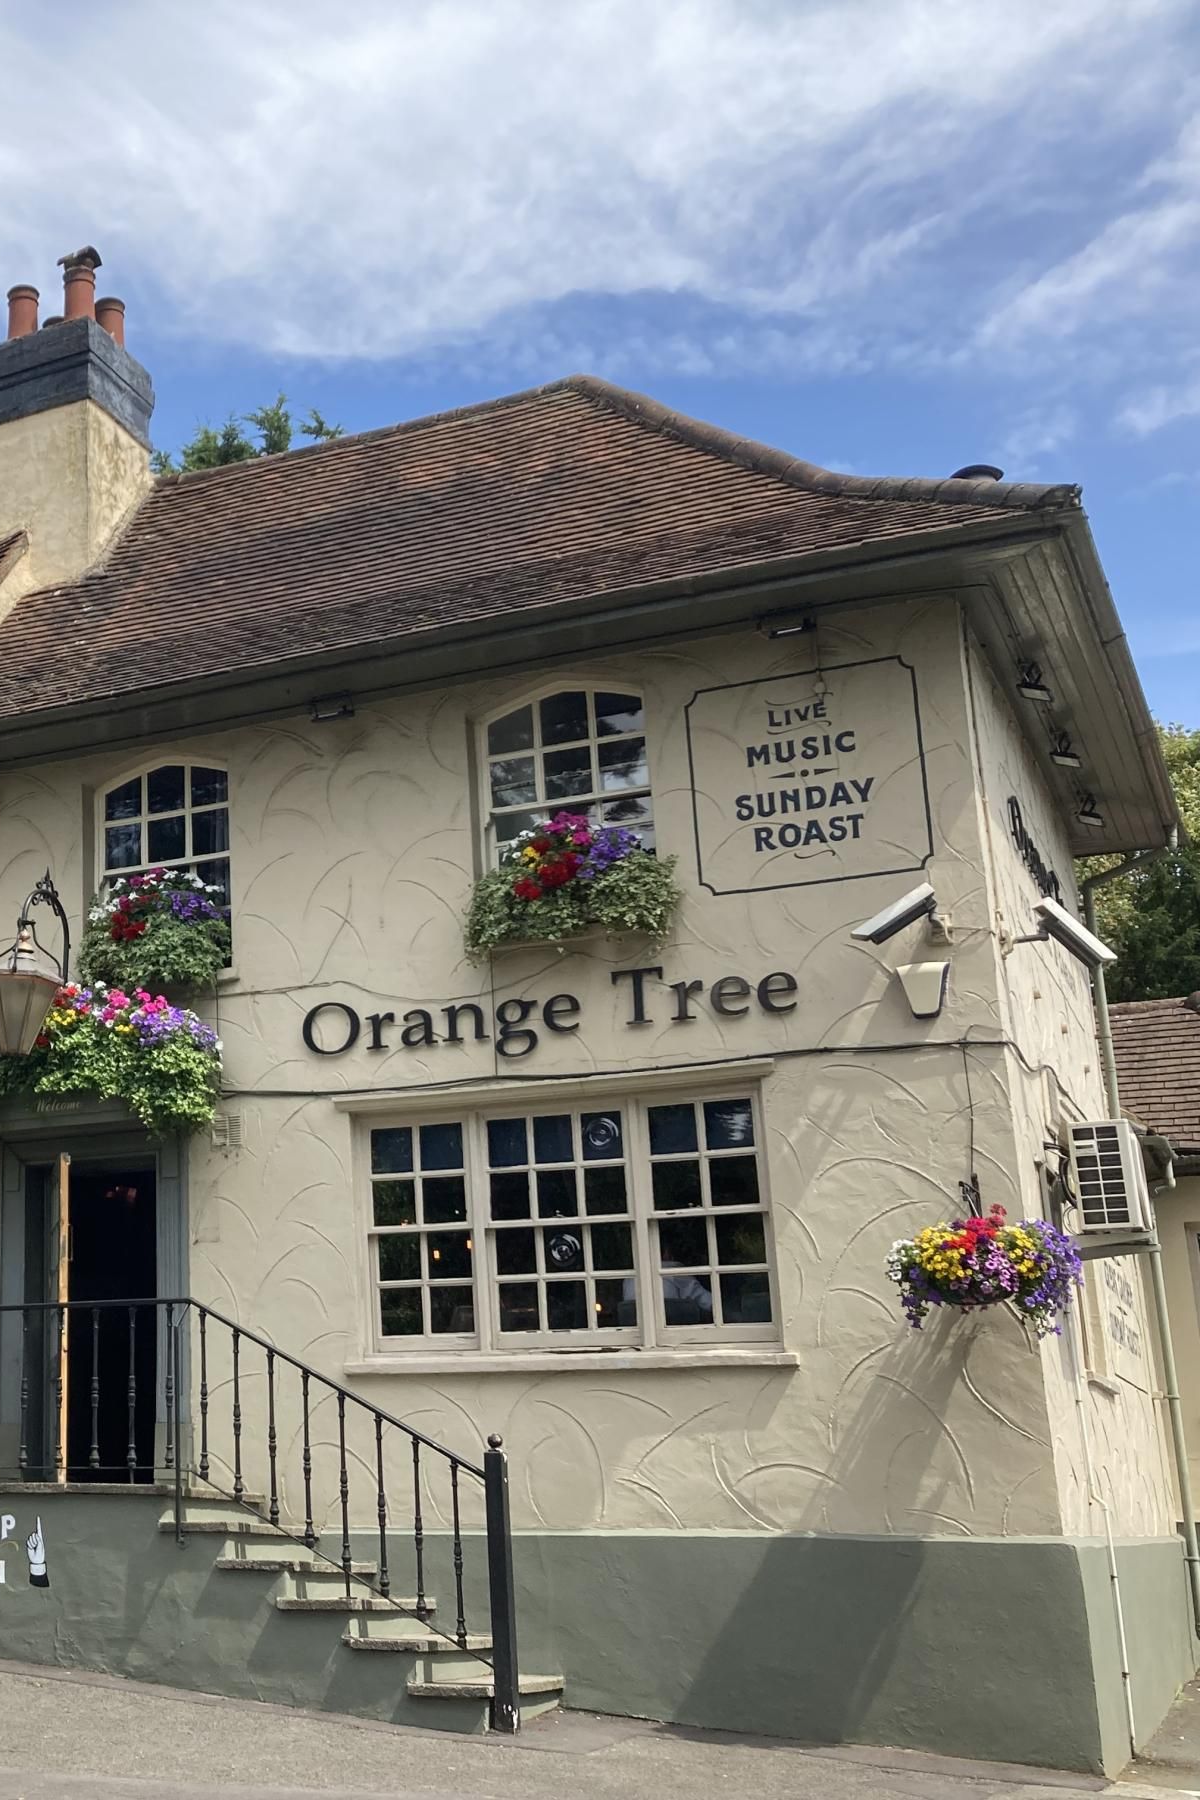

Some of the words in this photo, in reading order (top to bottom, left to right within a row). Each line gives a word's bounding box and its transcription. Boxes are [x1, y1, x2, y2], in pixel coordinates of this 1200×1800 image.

[767, 701, 828, 727] LIVE
[746, 730, 856, 768] MUSIC
[735, 777, 875, 821] SUNDAY
[754, 813, 864, 852] ROAST
[302, 992, 581, 1058] Orange
[611, 966, 798, 1025] Tree
